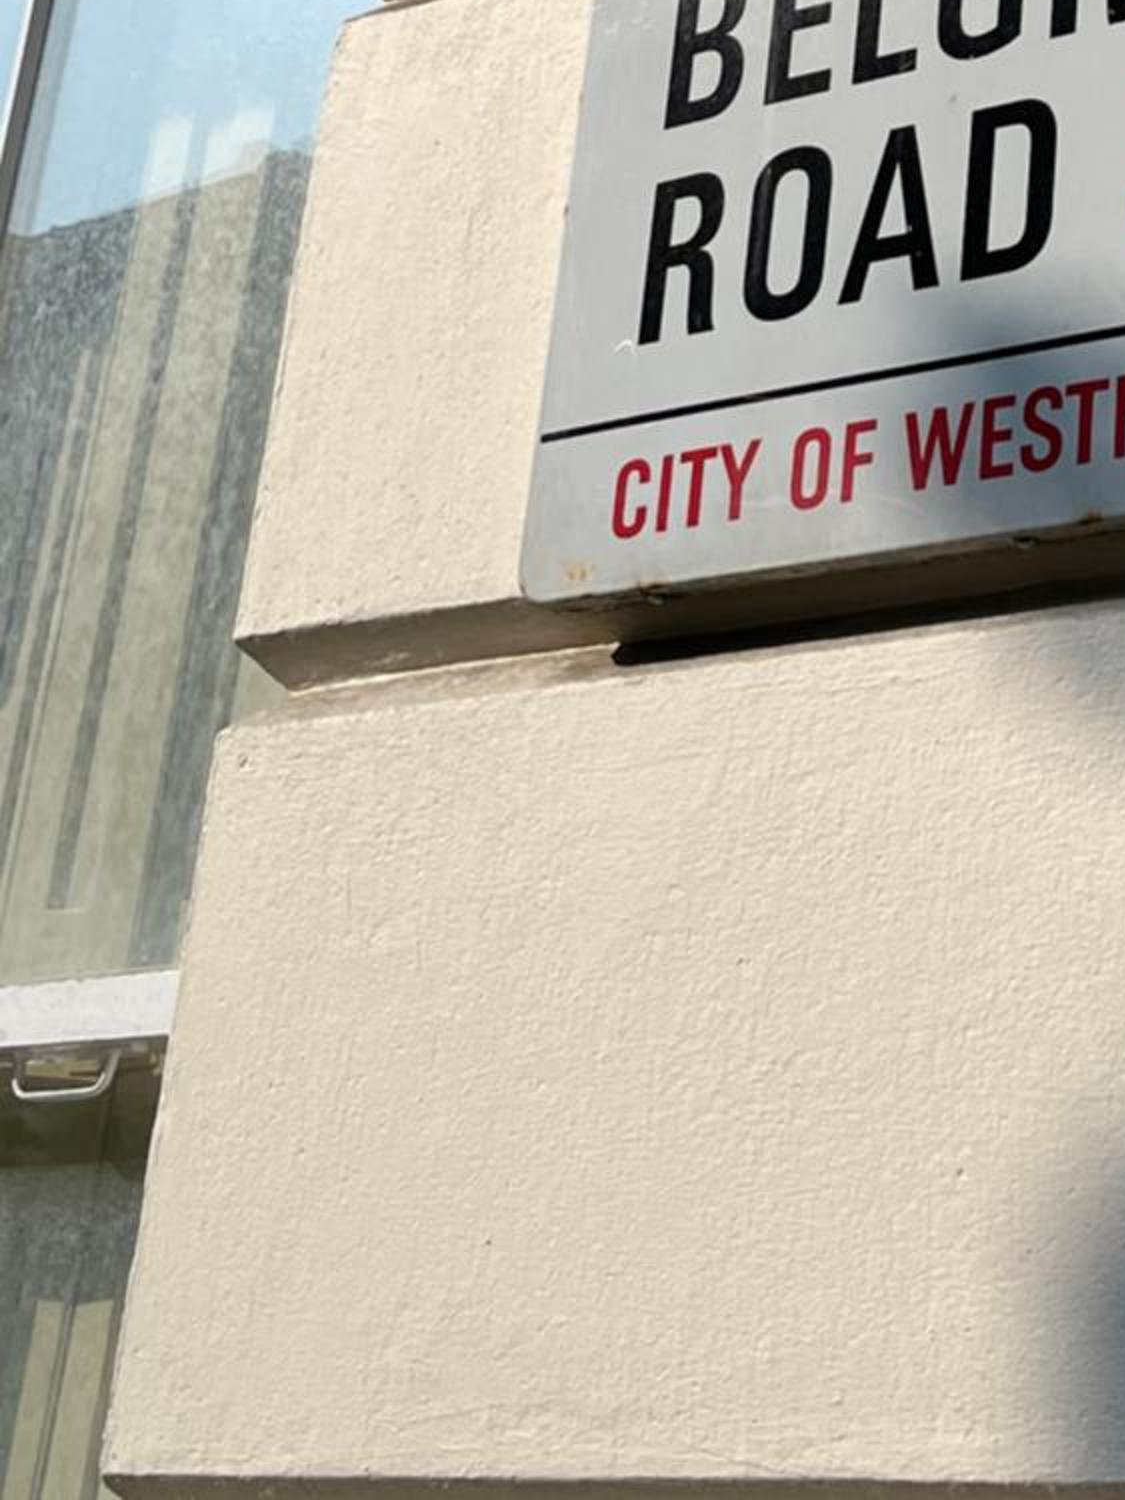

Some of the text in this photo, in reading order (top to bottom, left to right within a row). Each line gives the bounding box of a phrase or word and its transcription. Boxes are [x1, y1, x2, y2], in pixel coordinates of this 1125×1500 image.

[637, 98, 1058, 346] ROAD
[611, 439, 761, 540] CITY
[789, 419, 877, 511] OF
